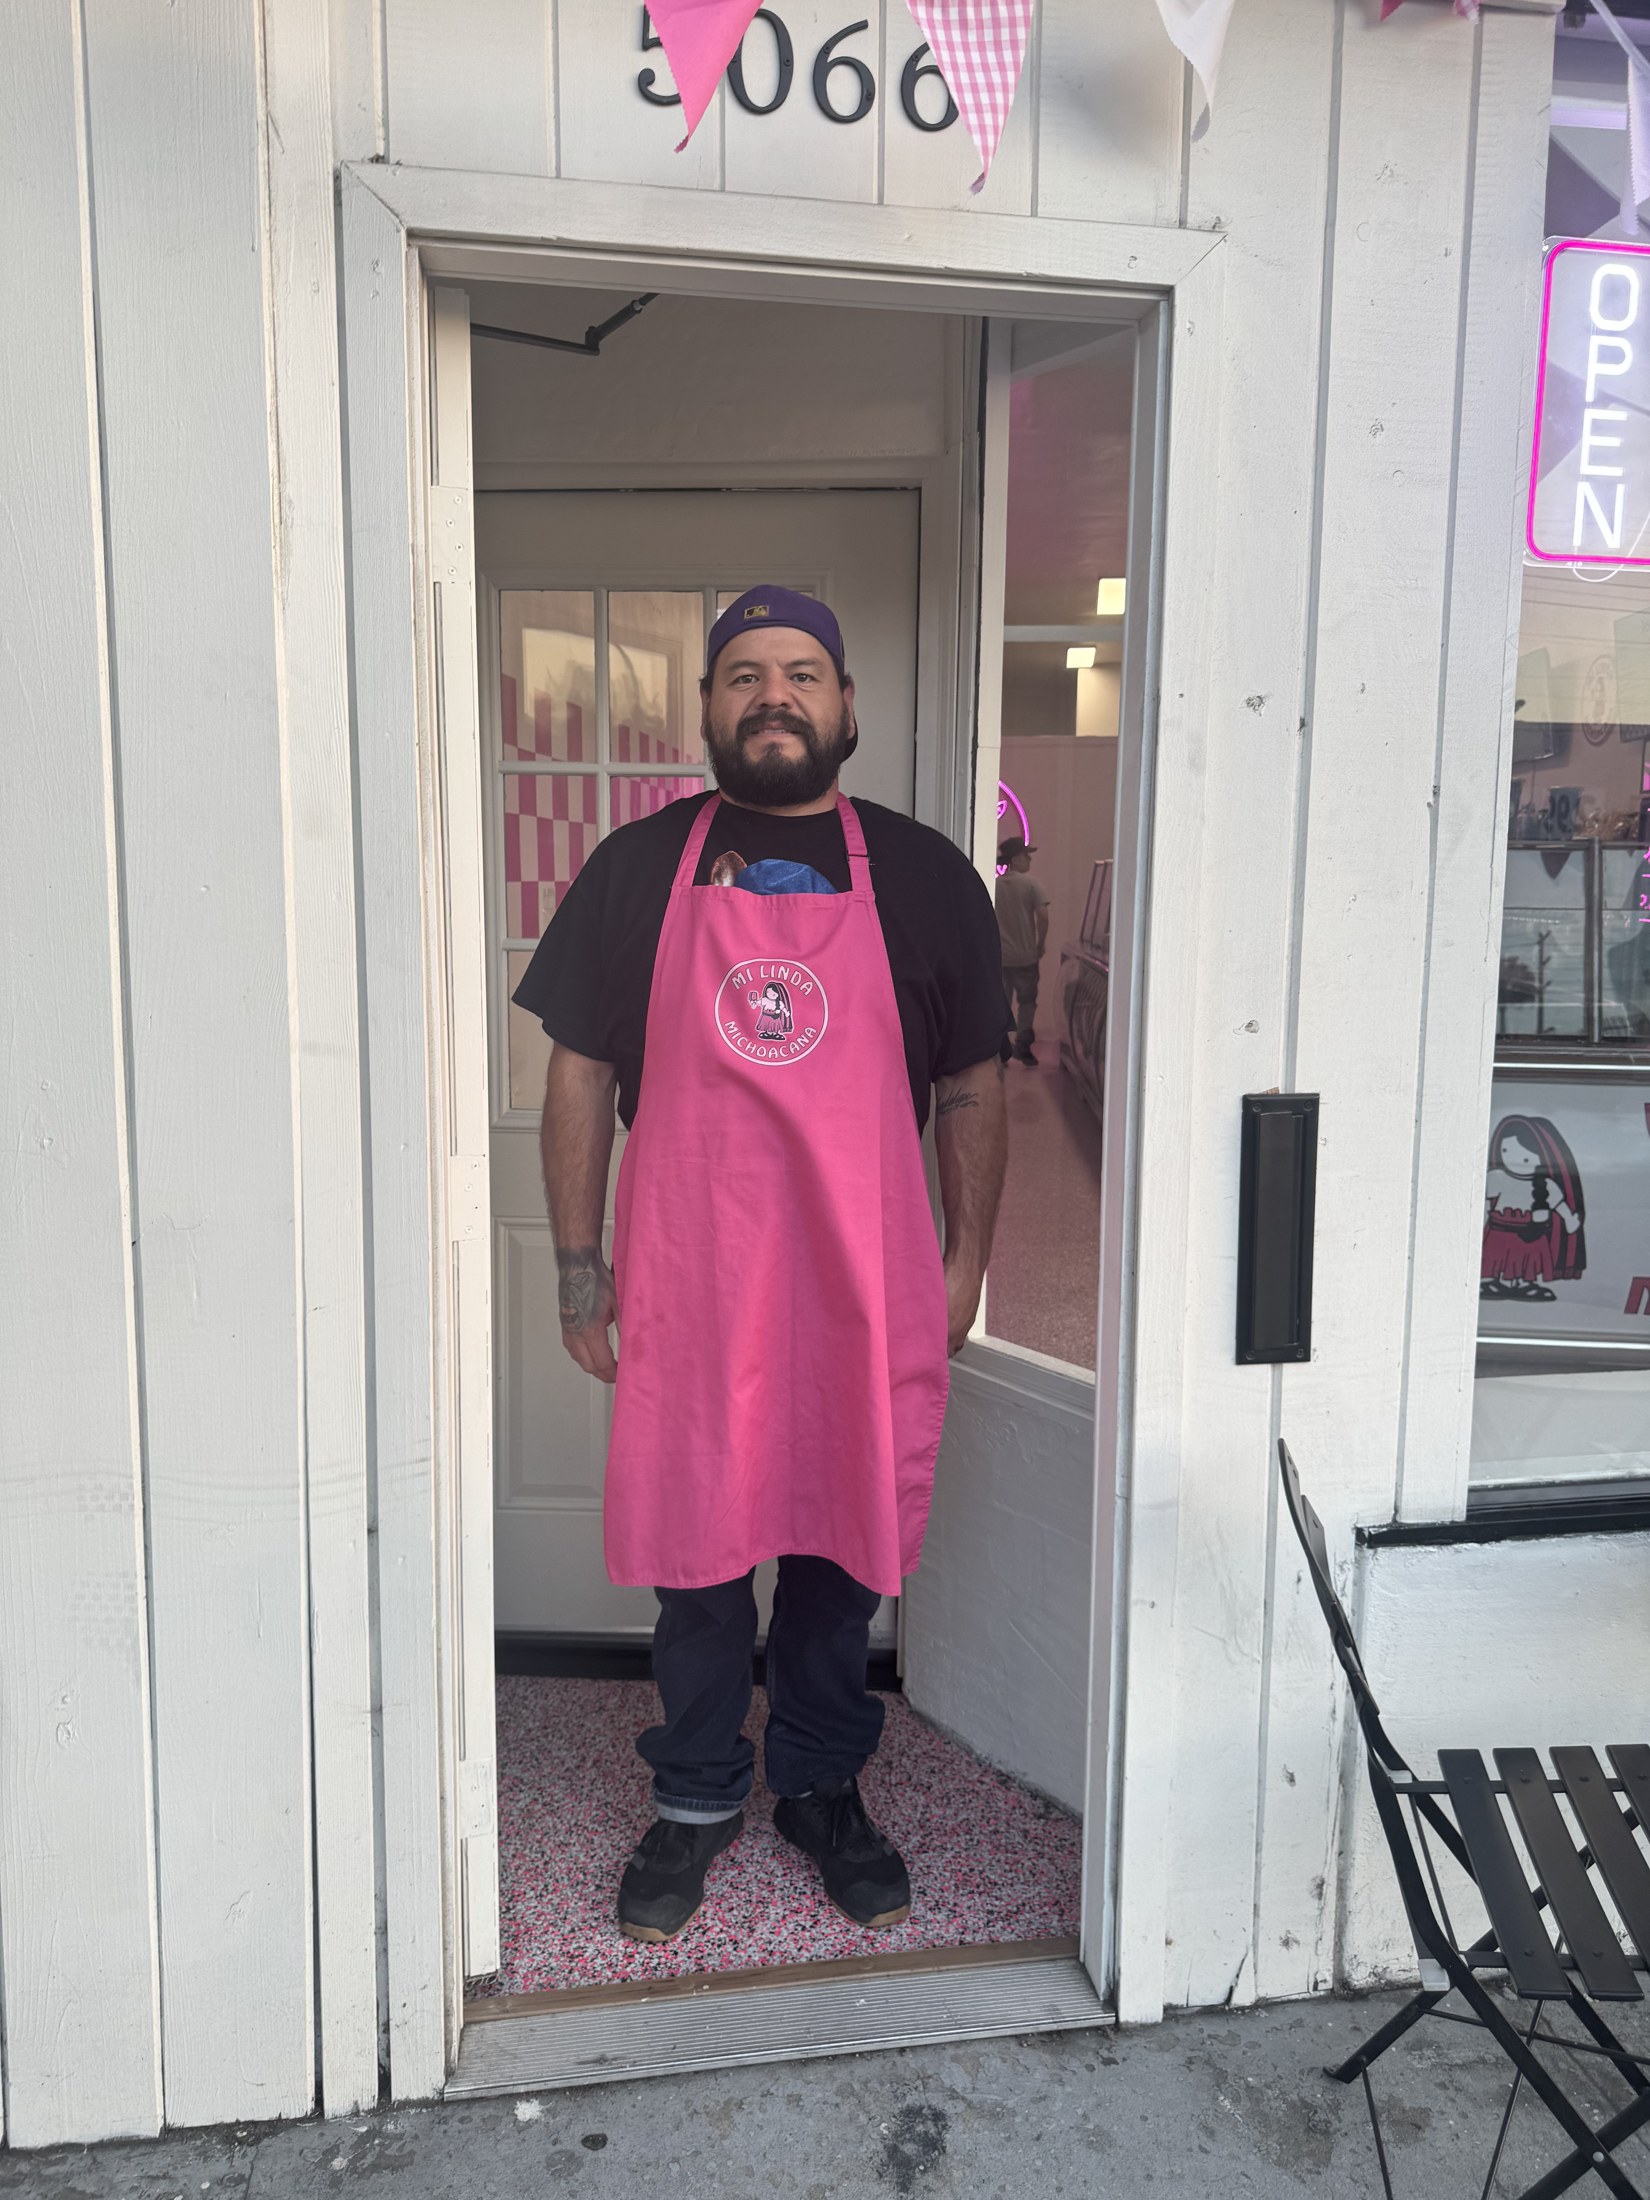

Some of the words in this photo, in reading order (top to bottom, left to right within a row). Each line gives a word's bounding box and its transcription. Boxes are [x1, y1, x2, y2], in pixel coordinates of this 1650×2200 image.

[1573, 263, 1639, 548] OPEN
[732, 968, 753, 989] MI
[760, 965, 813, 995] LINDA
[725, 1021, 816, 1058] MICHOACANA
